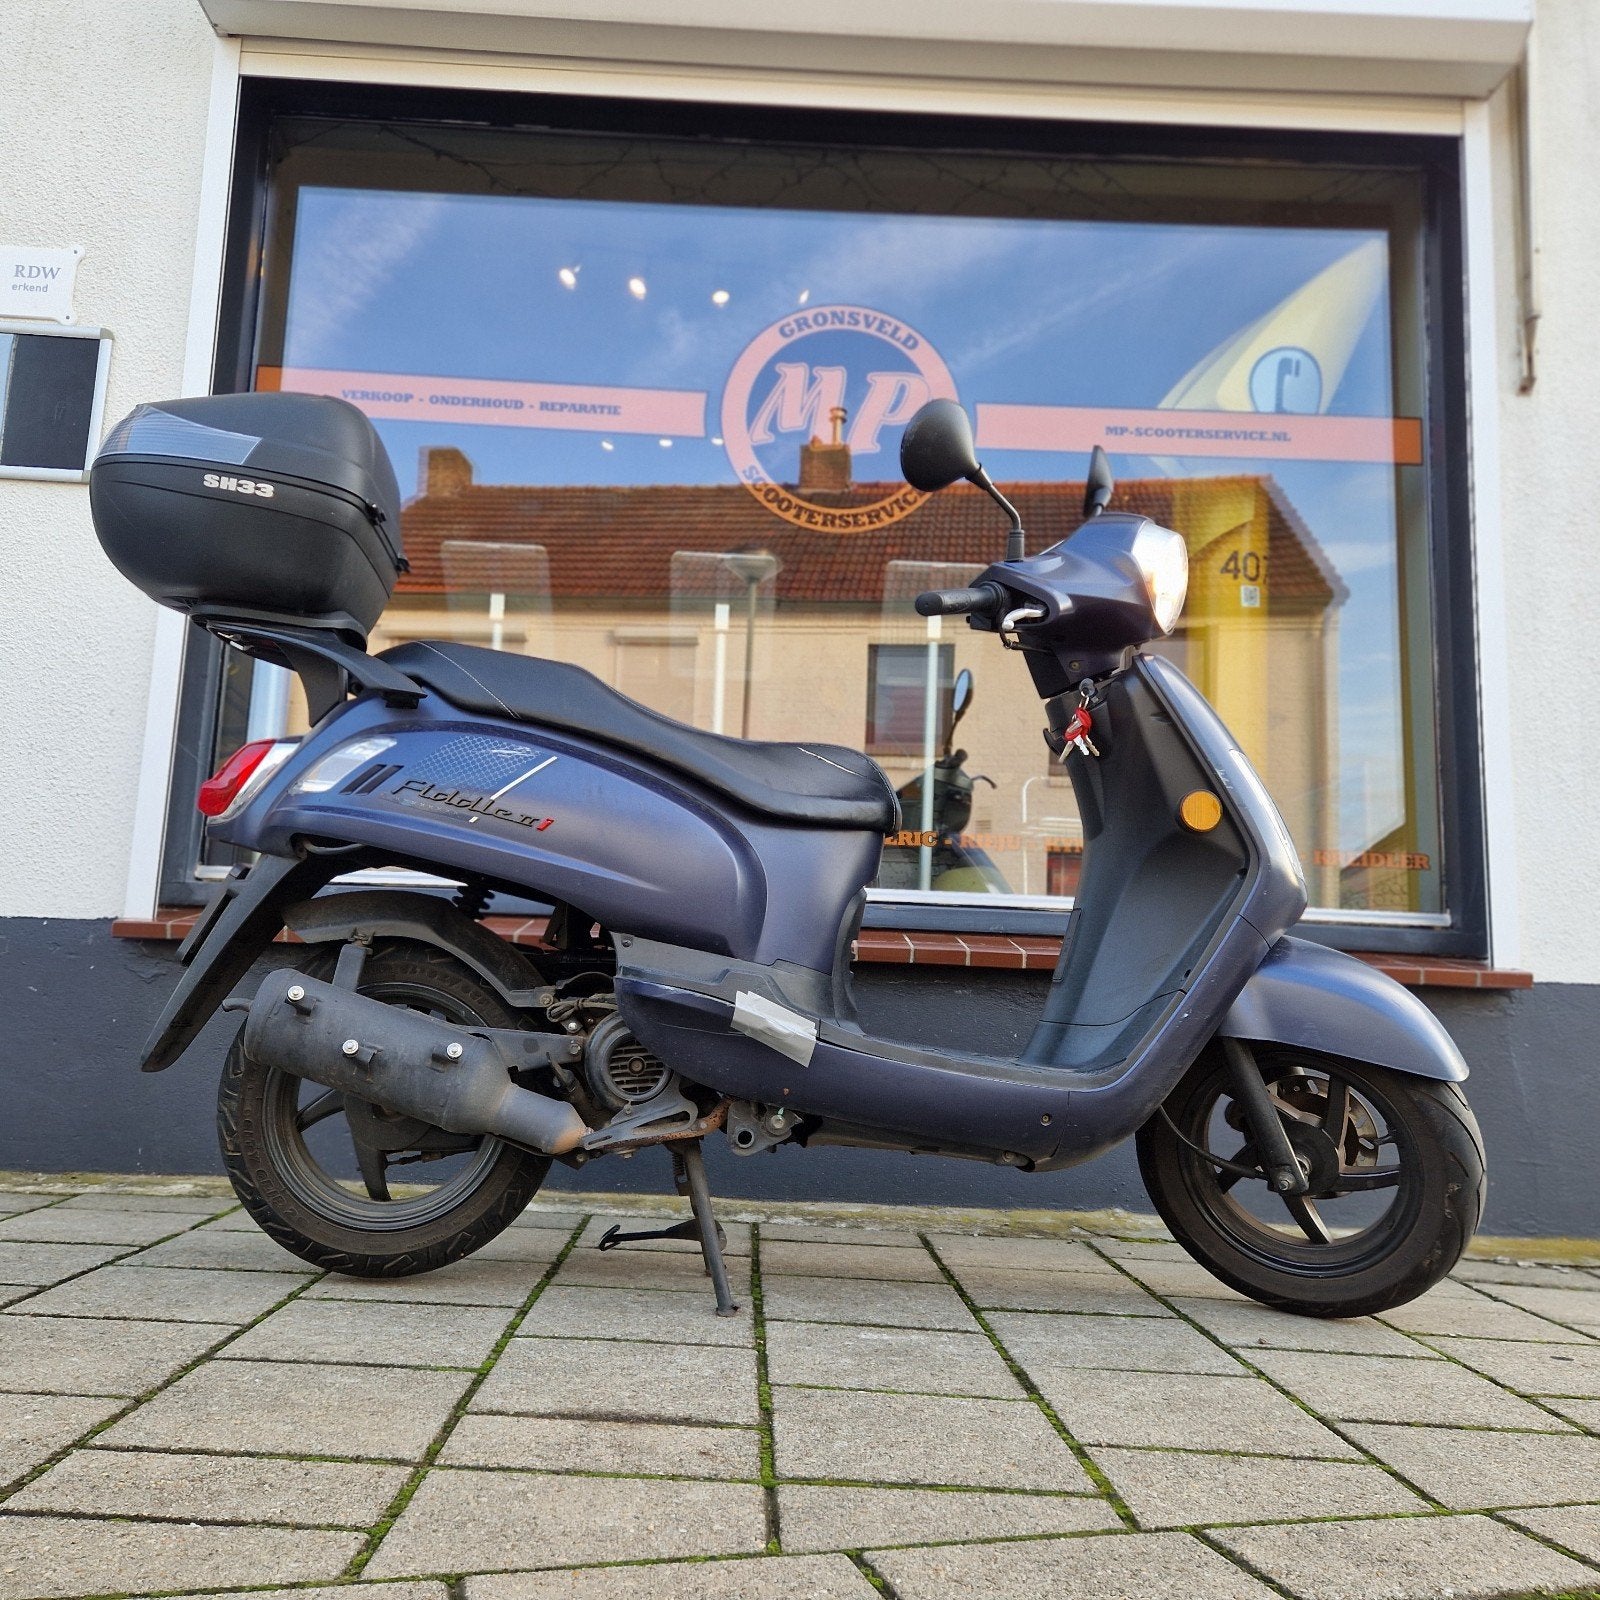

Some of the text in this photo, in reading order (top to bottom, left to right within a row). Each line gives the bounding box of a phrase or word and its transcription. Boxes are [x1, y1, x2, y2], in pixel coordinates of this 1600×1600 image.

[14, 264, 62, 280] RDW
[11, 282, 49, 294] erkend
[778, 310, 920, 352] GRONSVELD
[341, 388, 414, 404] VERKOOP
[428, 394, 525, 412] ONDERHOUD
[538, 400, 622, 417] REPARATIE
[1104, 424, 1292, 443] MP-SCOOTERSERVICE.NL
[202, 473, 275, 498] SH33
[1219, 550, 1268, 585] 40
